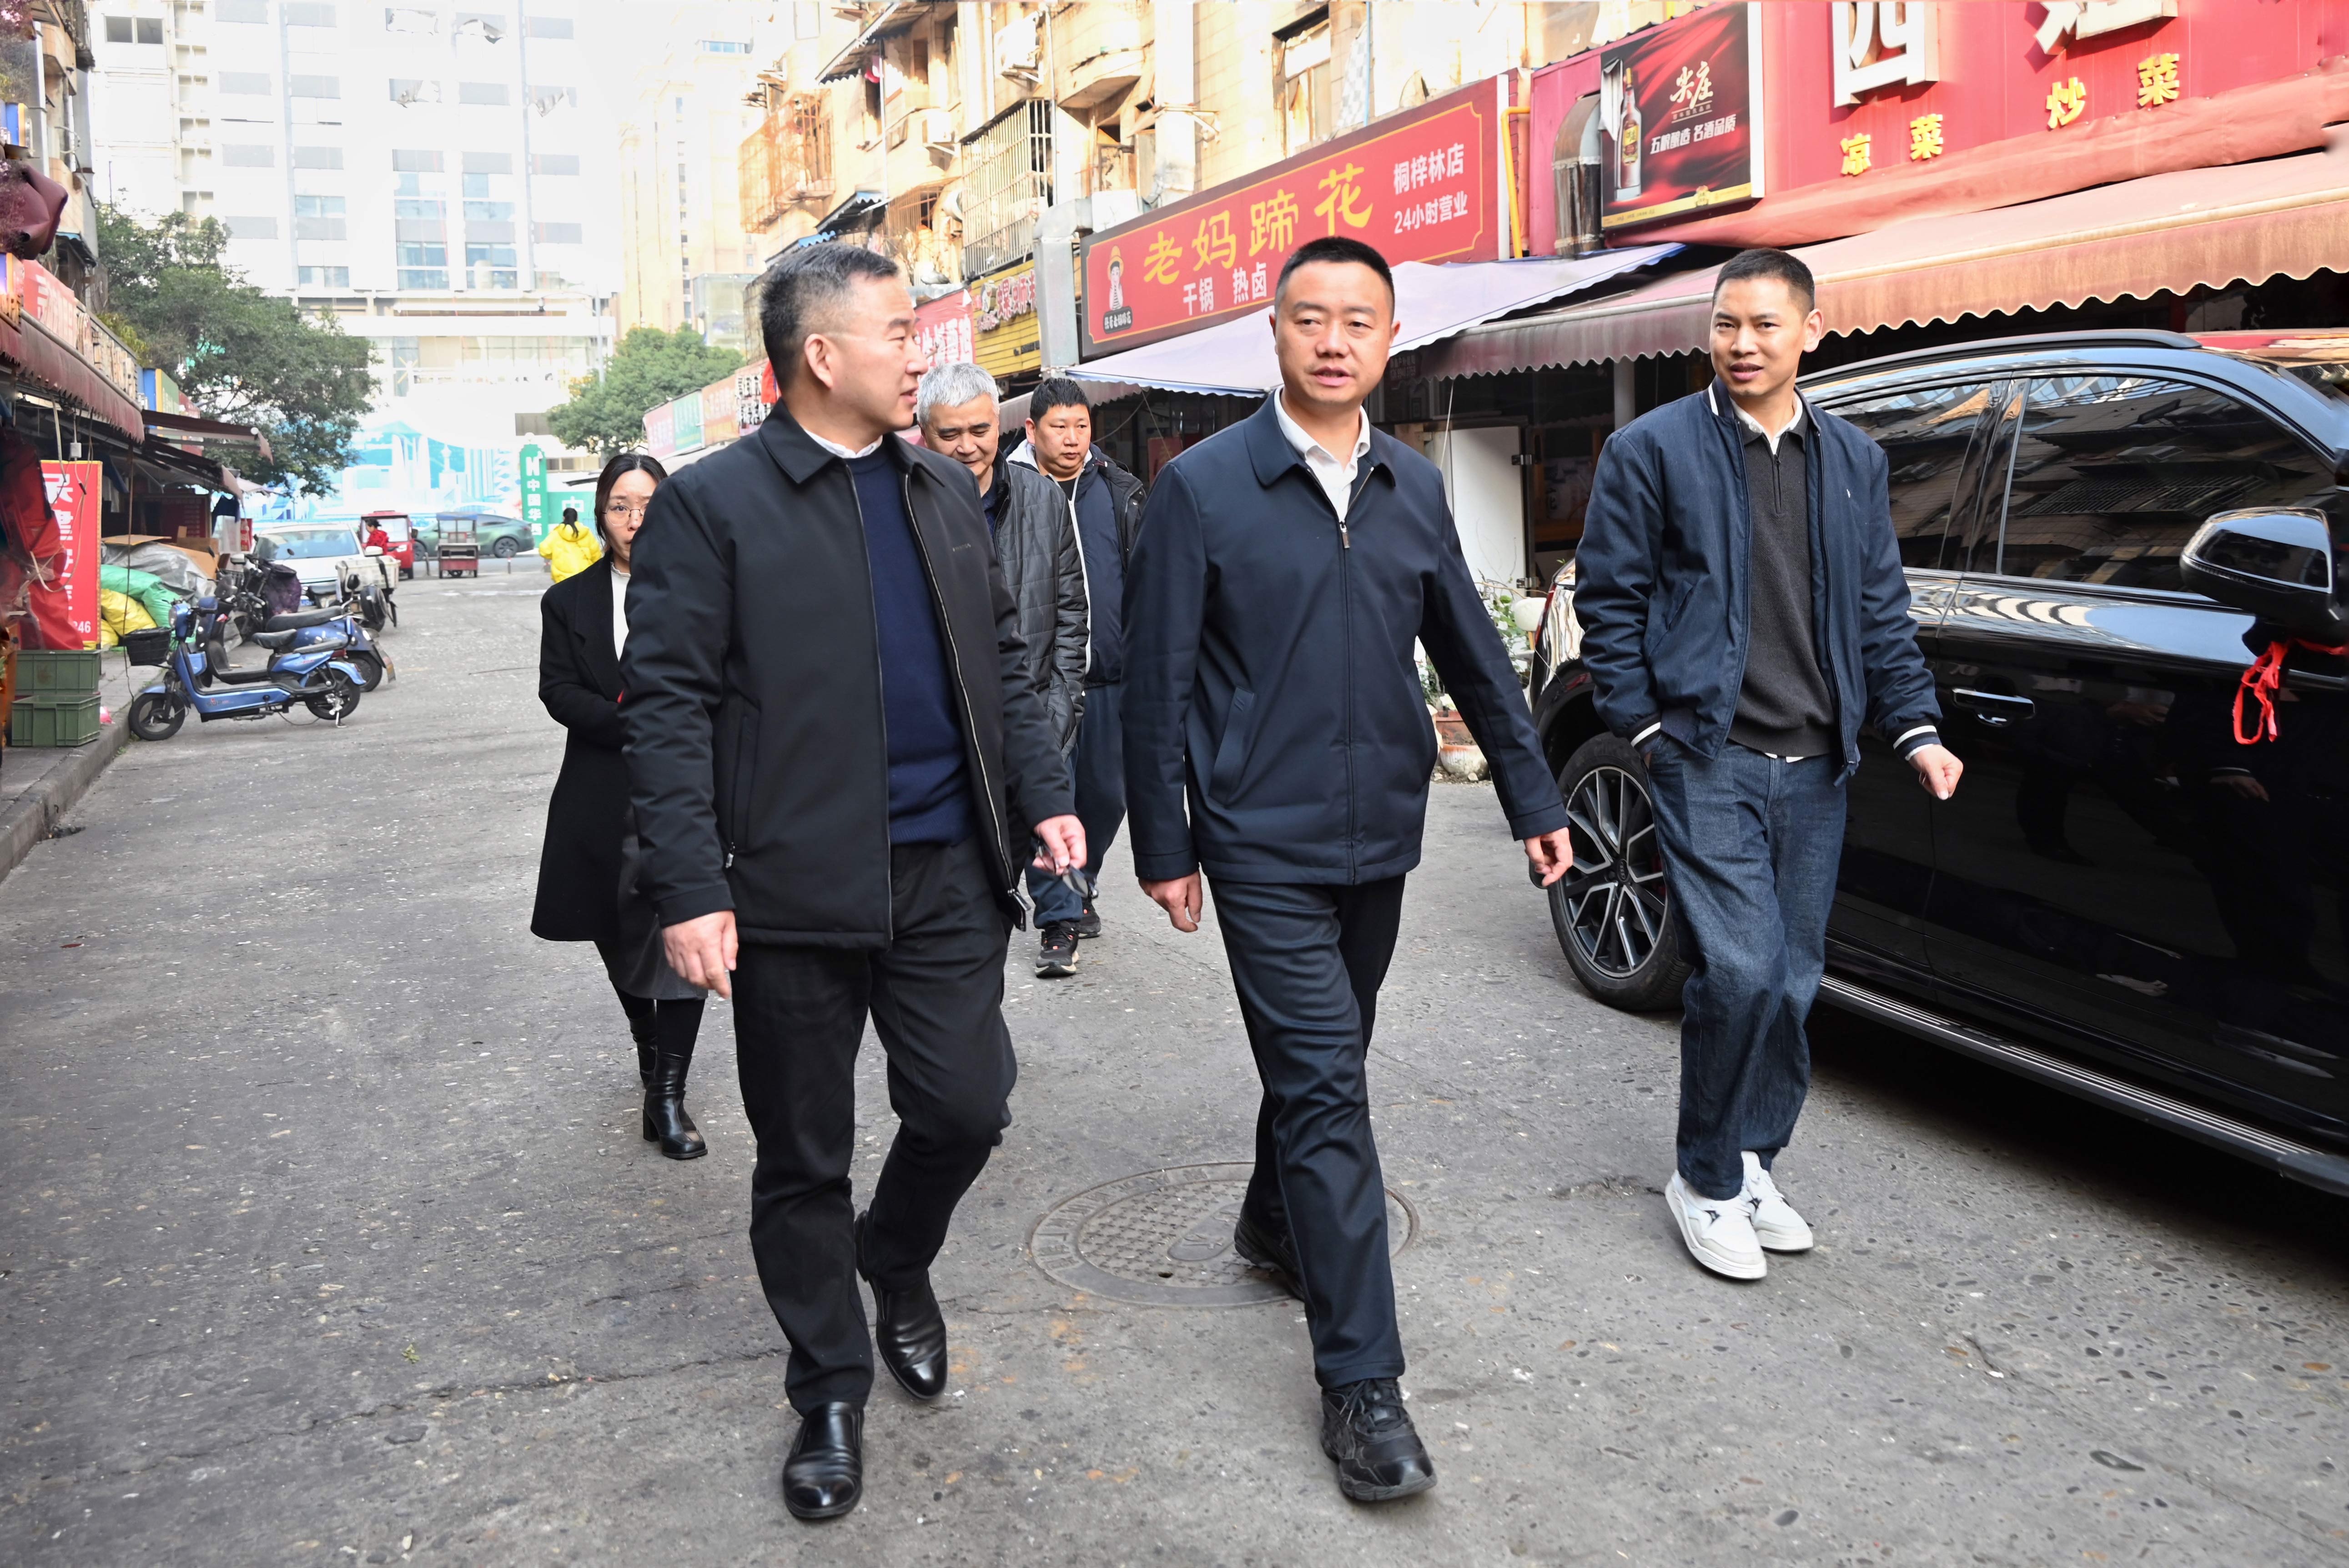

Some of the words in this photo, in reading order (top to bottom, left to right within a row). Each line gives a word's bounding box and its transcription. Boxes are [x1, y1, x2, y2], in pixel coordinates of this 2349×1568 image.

[1670, 60, 1713, 109] 尖庄
[1694, 114, 1736, 142] 名酒品质
[1841, 114, 1943, 175] 凉菜
[2047, 53, 2179, 129] 炒菜
[1393, 142, 1464, 194] 桐梓林店
[1143, 163, 1373, 285] 老妈蹄花
[1394, 191, 1468, 233] 24小时营业
[1183, 277, 1214, 315] 干锅
[1232, 262, 1267, 304] 热卤
